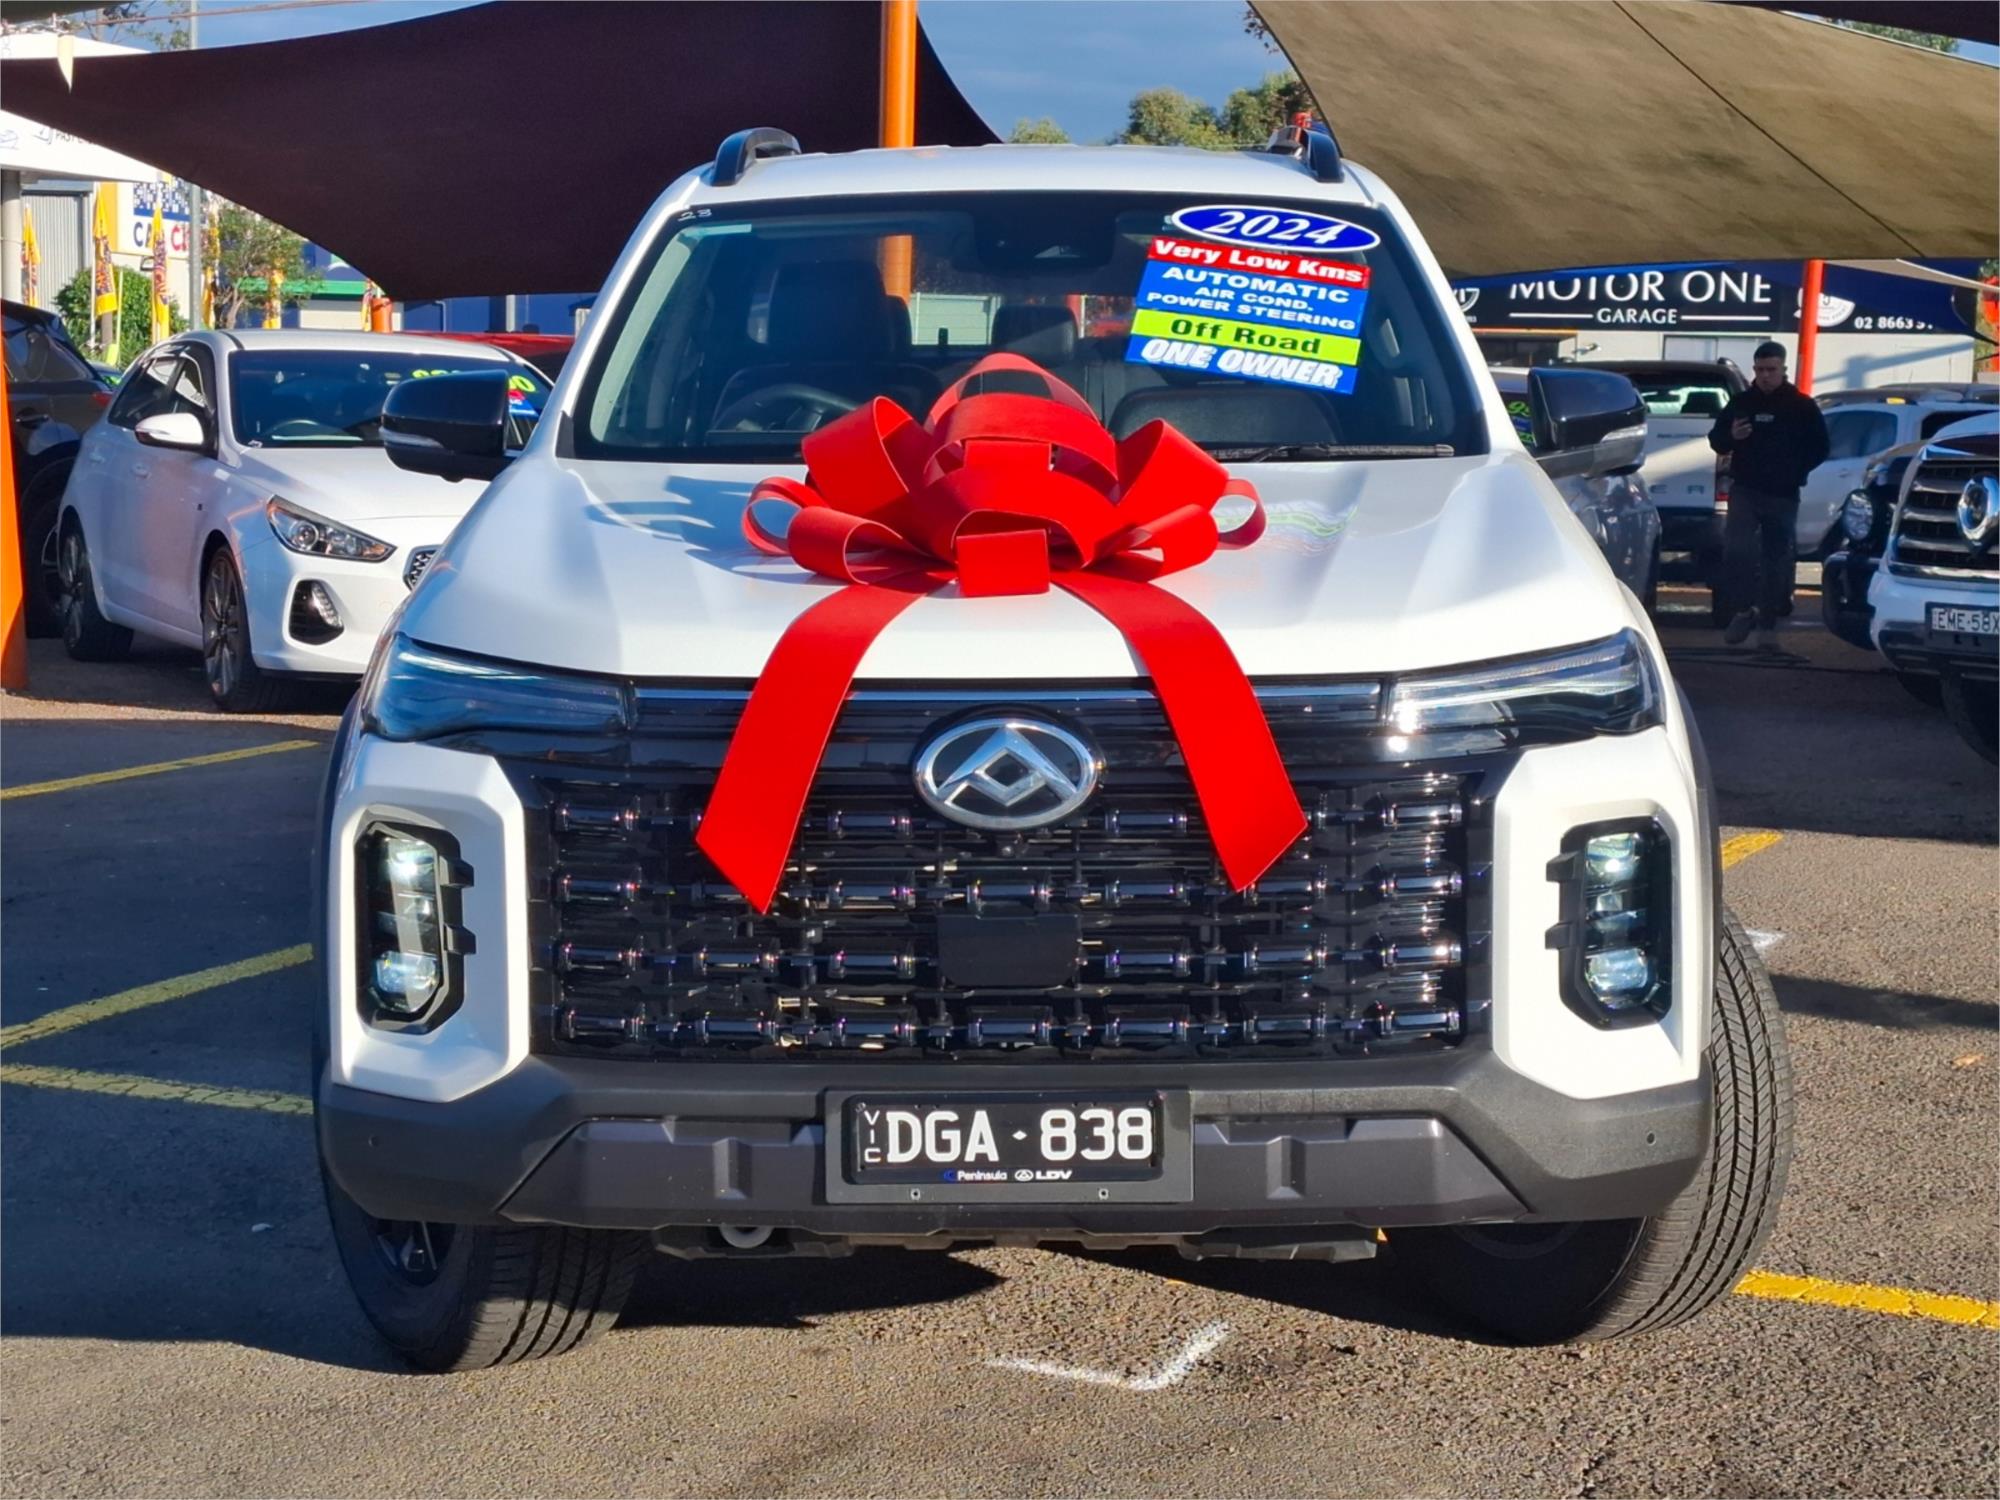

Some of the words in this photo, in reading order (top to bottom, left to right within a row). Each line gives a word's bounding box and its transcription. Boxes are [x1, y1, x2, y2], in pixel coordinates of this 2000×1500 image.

[1203, 211, 1348, 244] 2024
[1154, 239, 1222, 264] Very
[1229, 250, 1291, 271] Low
[1297, 260, 1363, 283] Kms
[1162, 266, 1350, 303] AUTOMATIC
[1195, 287, 1236, 301] AIR
[1242, 292, 1314, 312] COND.
[1681, 270, 1772, 303] ONE
[1147, 292, 1231, 312] POWER
[1237, 304, 1356, 330] STEERING
[1596, 307, 1678, 324] GARAGE
[1854, 316, 1873, 330] 02
[1170, 318, 1223, 340] Off
[1233, 327, 1321, 354] Road
[1141, 338, 1217, 369] ONE
[1217, 349, 1343, 389] OWNER
[863, 1110, 881, 1163] VIC
[886, 1110, 1000, 1163] DGA
[1040, 1108, 1153, 1161] 838
[957, 1169, 1007, 1181] Peninsula
[1035, 1170, 1073, 1180] LDV
